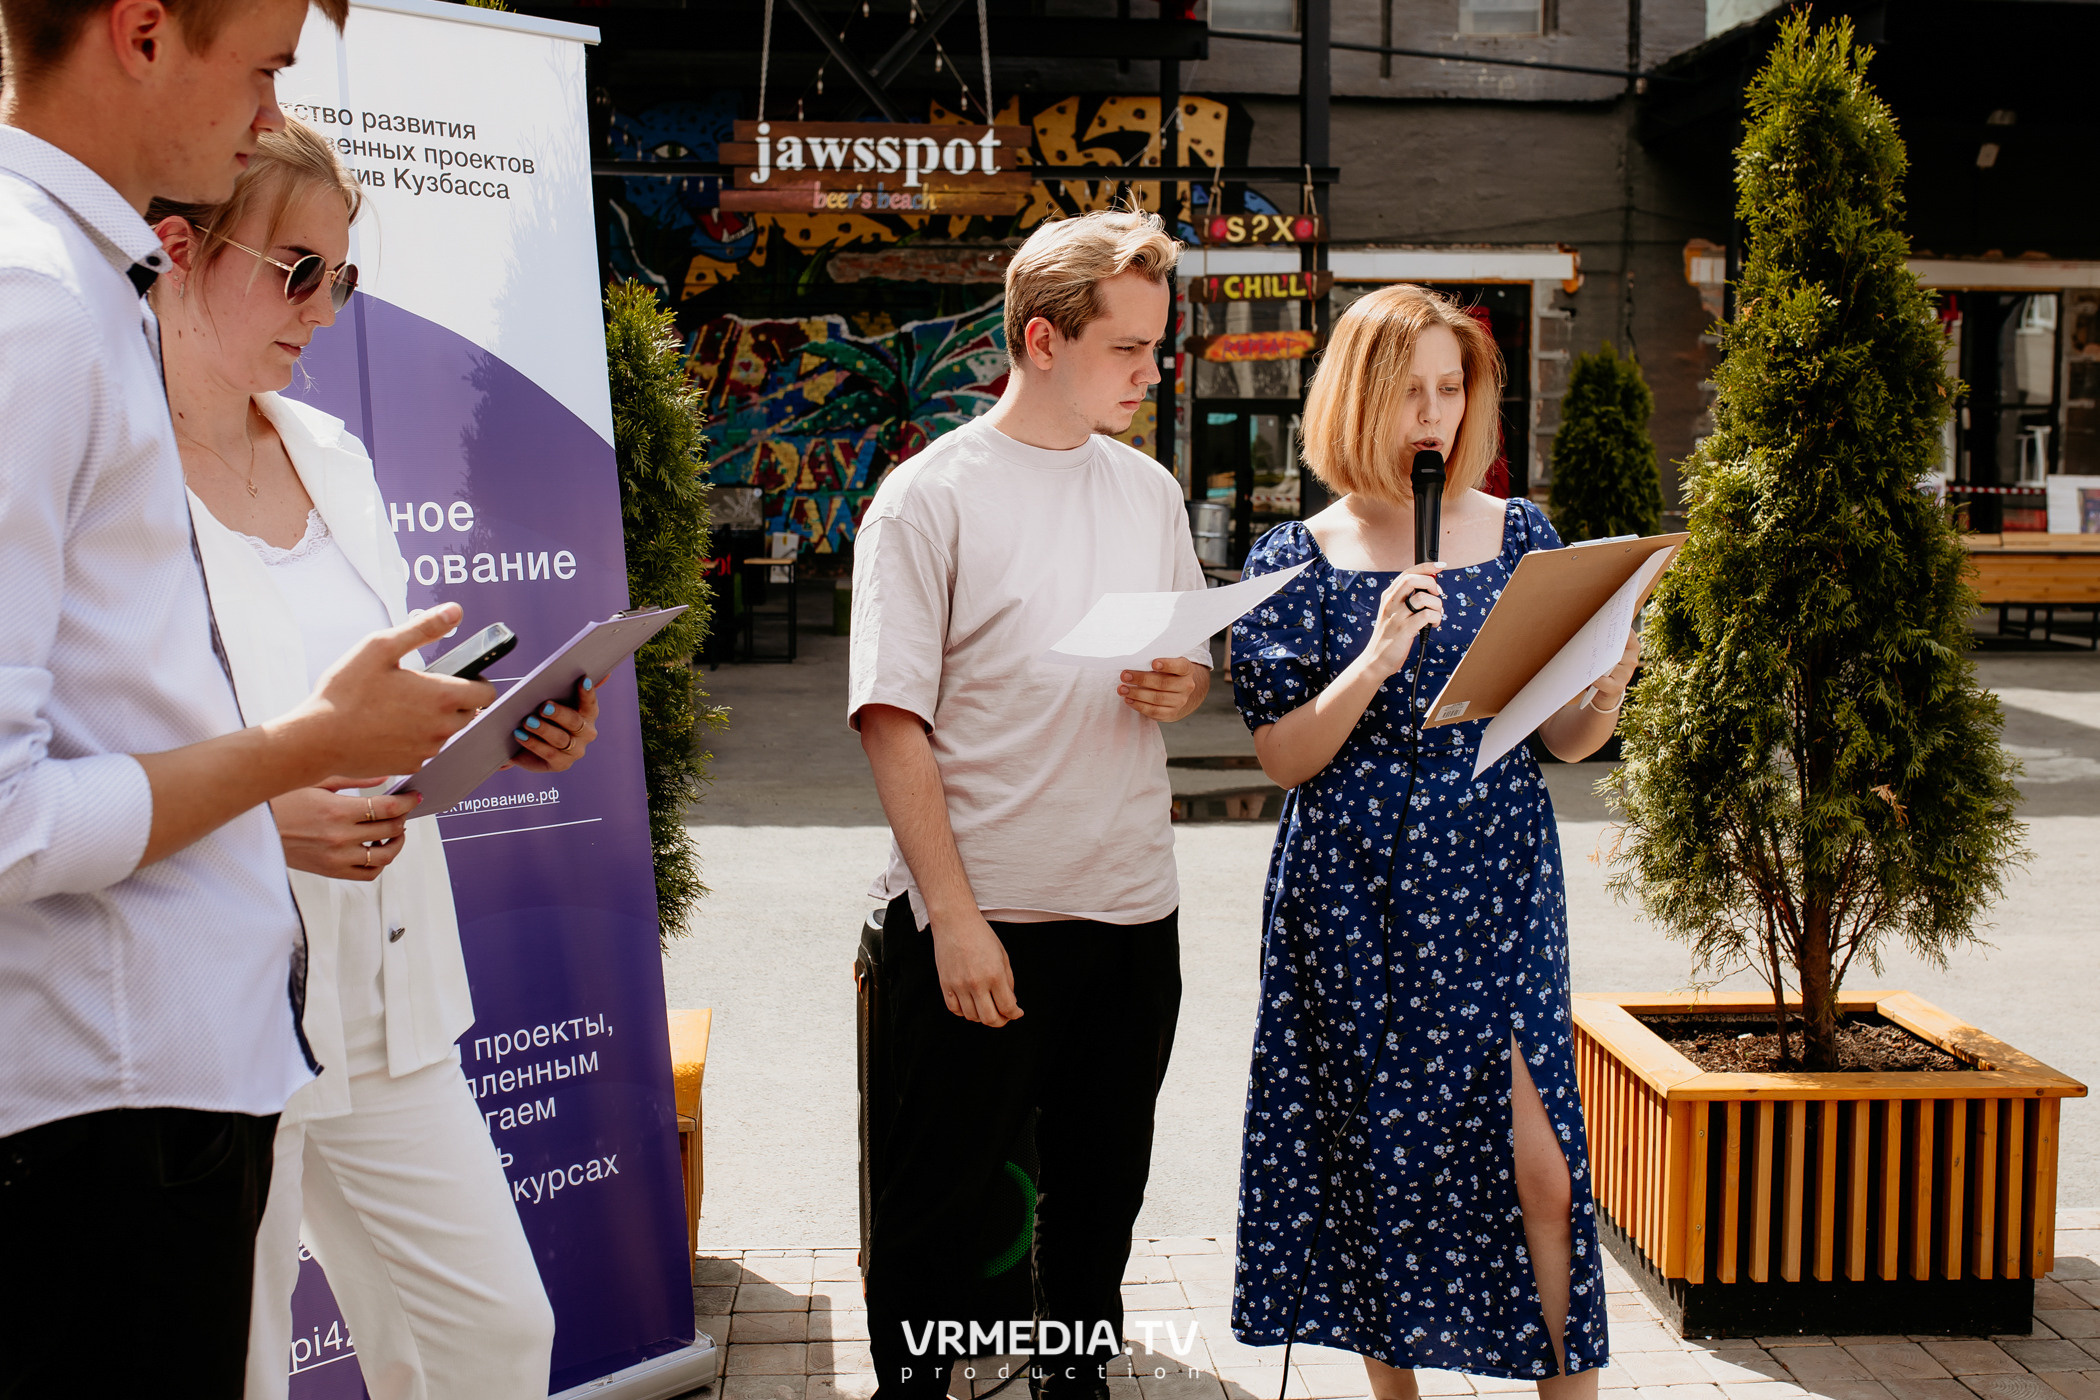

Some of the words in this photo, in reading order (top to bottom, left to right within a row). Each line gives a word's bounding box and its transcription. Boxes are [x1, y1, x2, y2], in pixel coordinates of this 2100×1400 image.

[362, 107, 476, 141] развития
[424, 145, 535, 175] проектов
[750, 121, 1002, 187] jawsspot
[394, 167, 511, 200] Кузбасса
[813, 181, 873, 211] beer's
[876, 182, 937, 212] beach
[1225, 214, 1295, 243] S?X
[1223, 274, 1307, 300] CHILL
[441, 787, 560, 814] тирование.рф
[474, 1012, 614, 1064] проекты,
